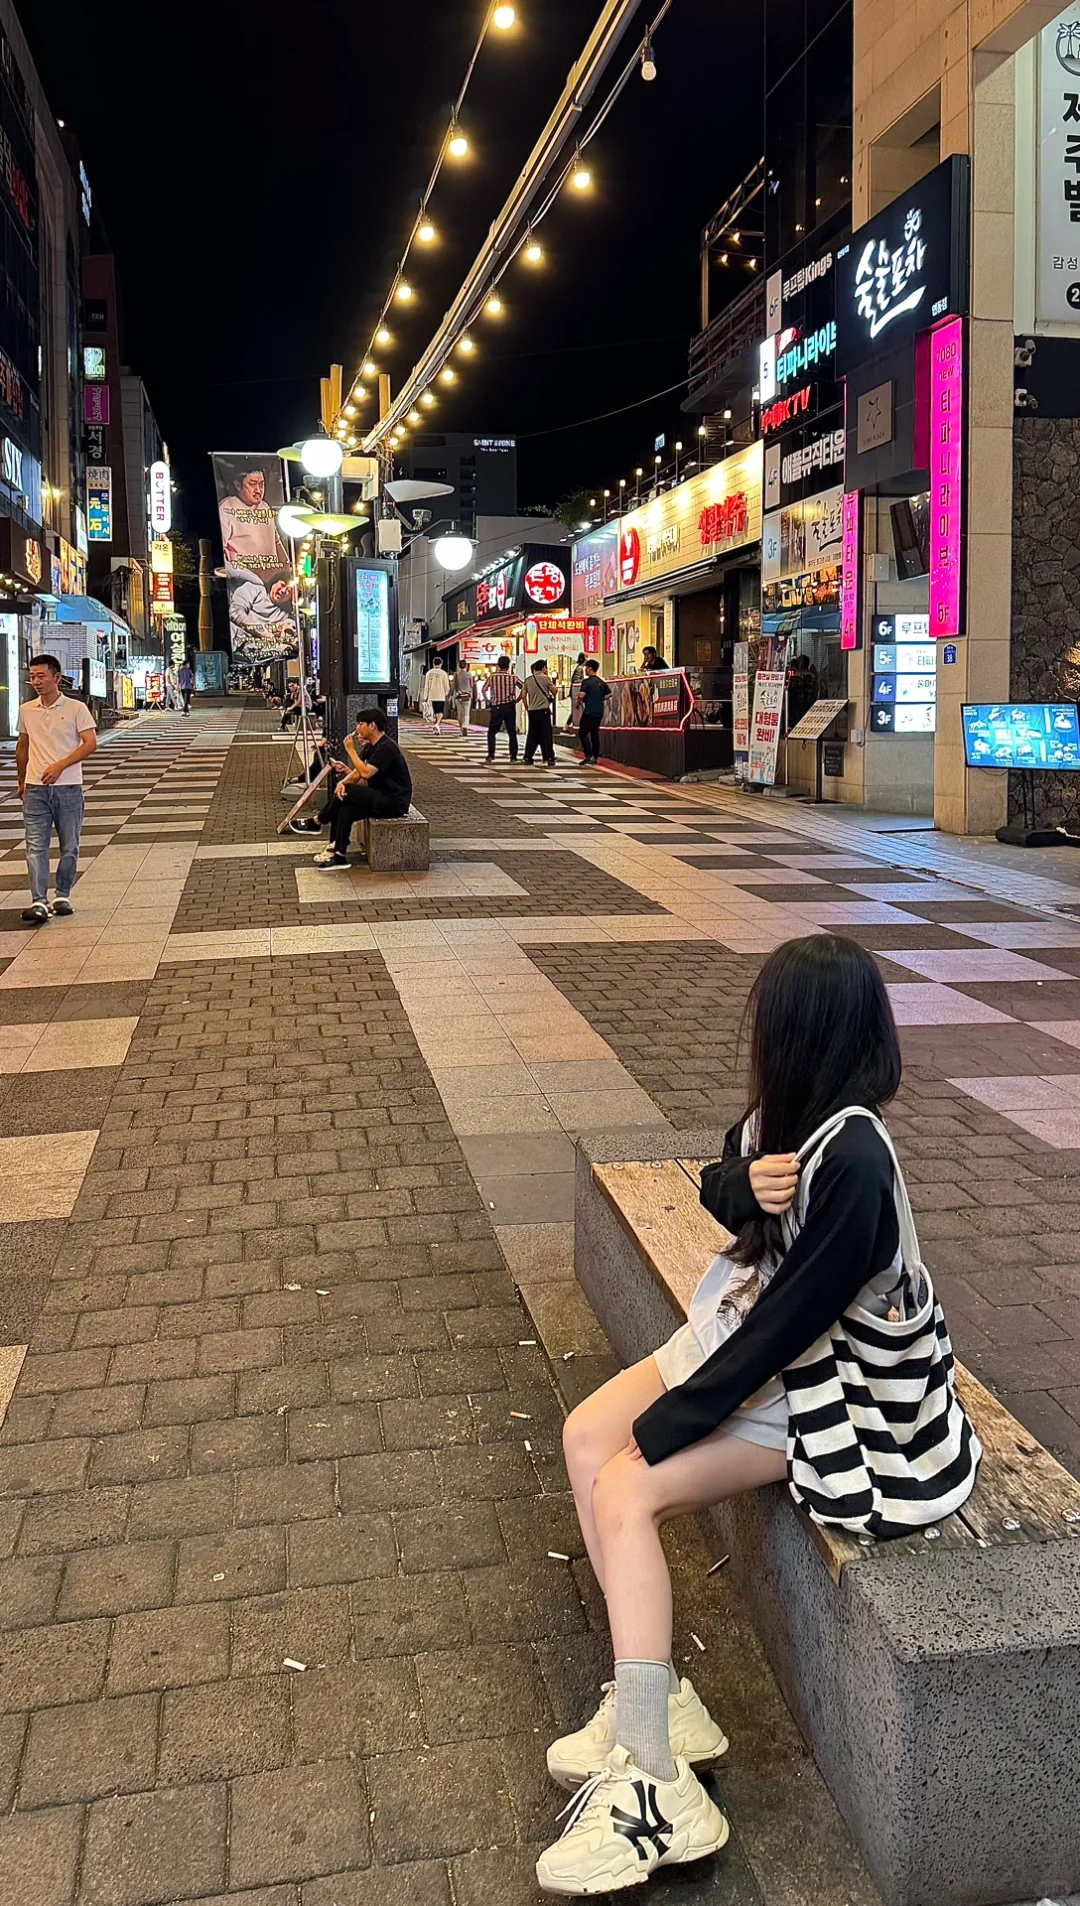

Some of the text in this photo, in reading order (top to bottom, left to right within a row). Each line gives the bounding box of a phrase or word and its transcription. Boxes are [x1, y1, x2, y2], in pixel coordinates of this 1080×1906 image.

[1053, 256, 1078, 270] 감성
[769, 296, 779, 317] 6F
[936, 342, 957, 364] 7080
[937, 366, 955, 382] new
[88, 431, 103, 459] 서경
[782, 429, 844, 484] 애플뮤직타운
[767, 538, 778, 559] 3F
[937, 601, 950, 623] 5F
[878, 620, 893, 636] 6F
[879, 651, 893, 665] 5F
[878, 681, 893, 696] 4F
[755, 711, 780, 727] 대형룸
[877, 710, 892, 725] 3F
